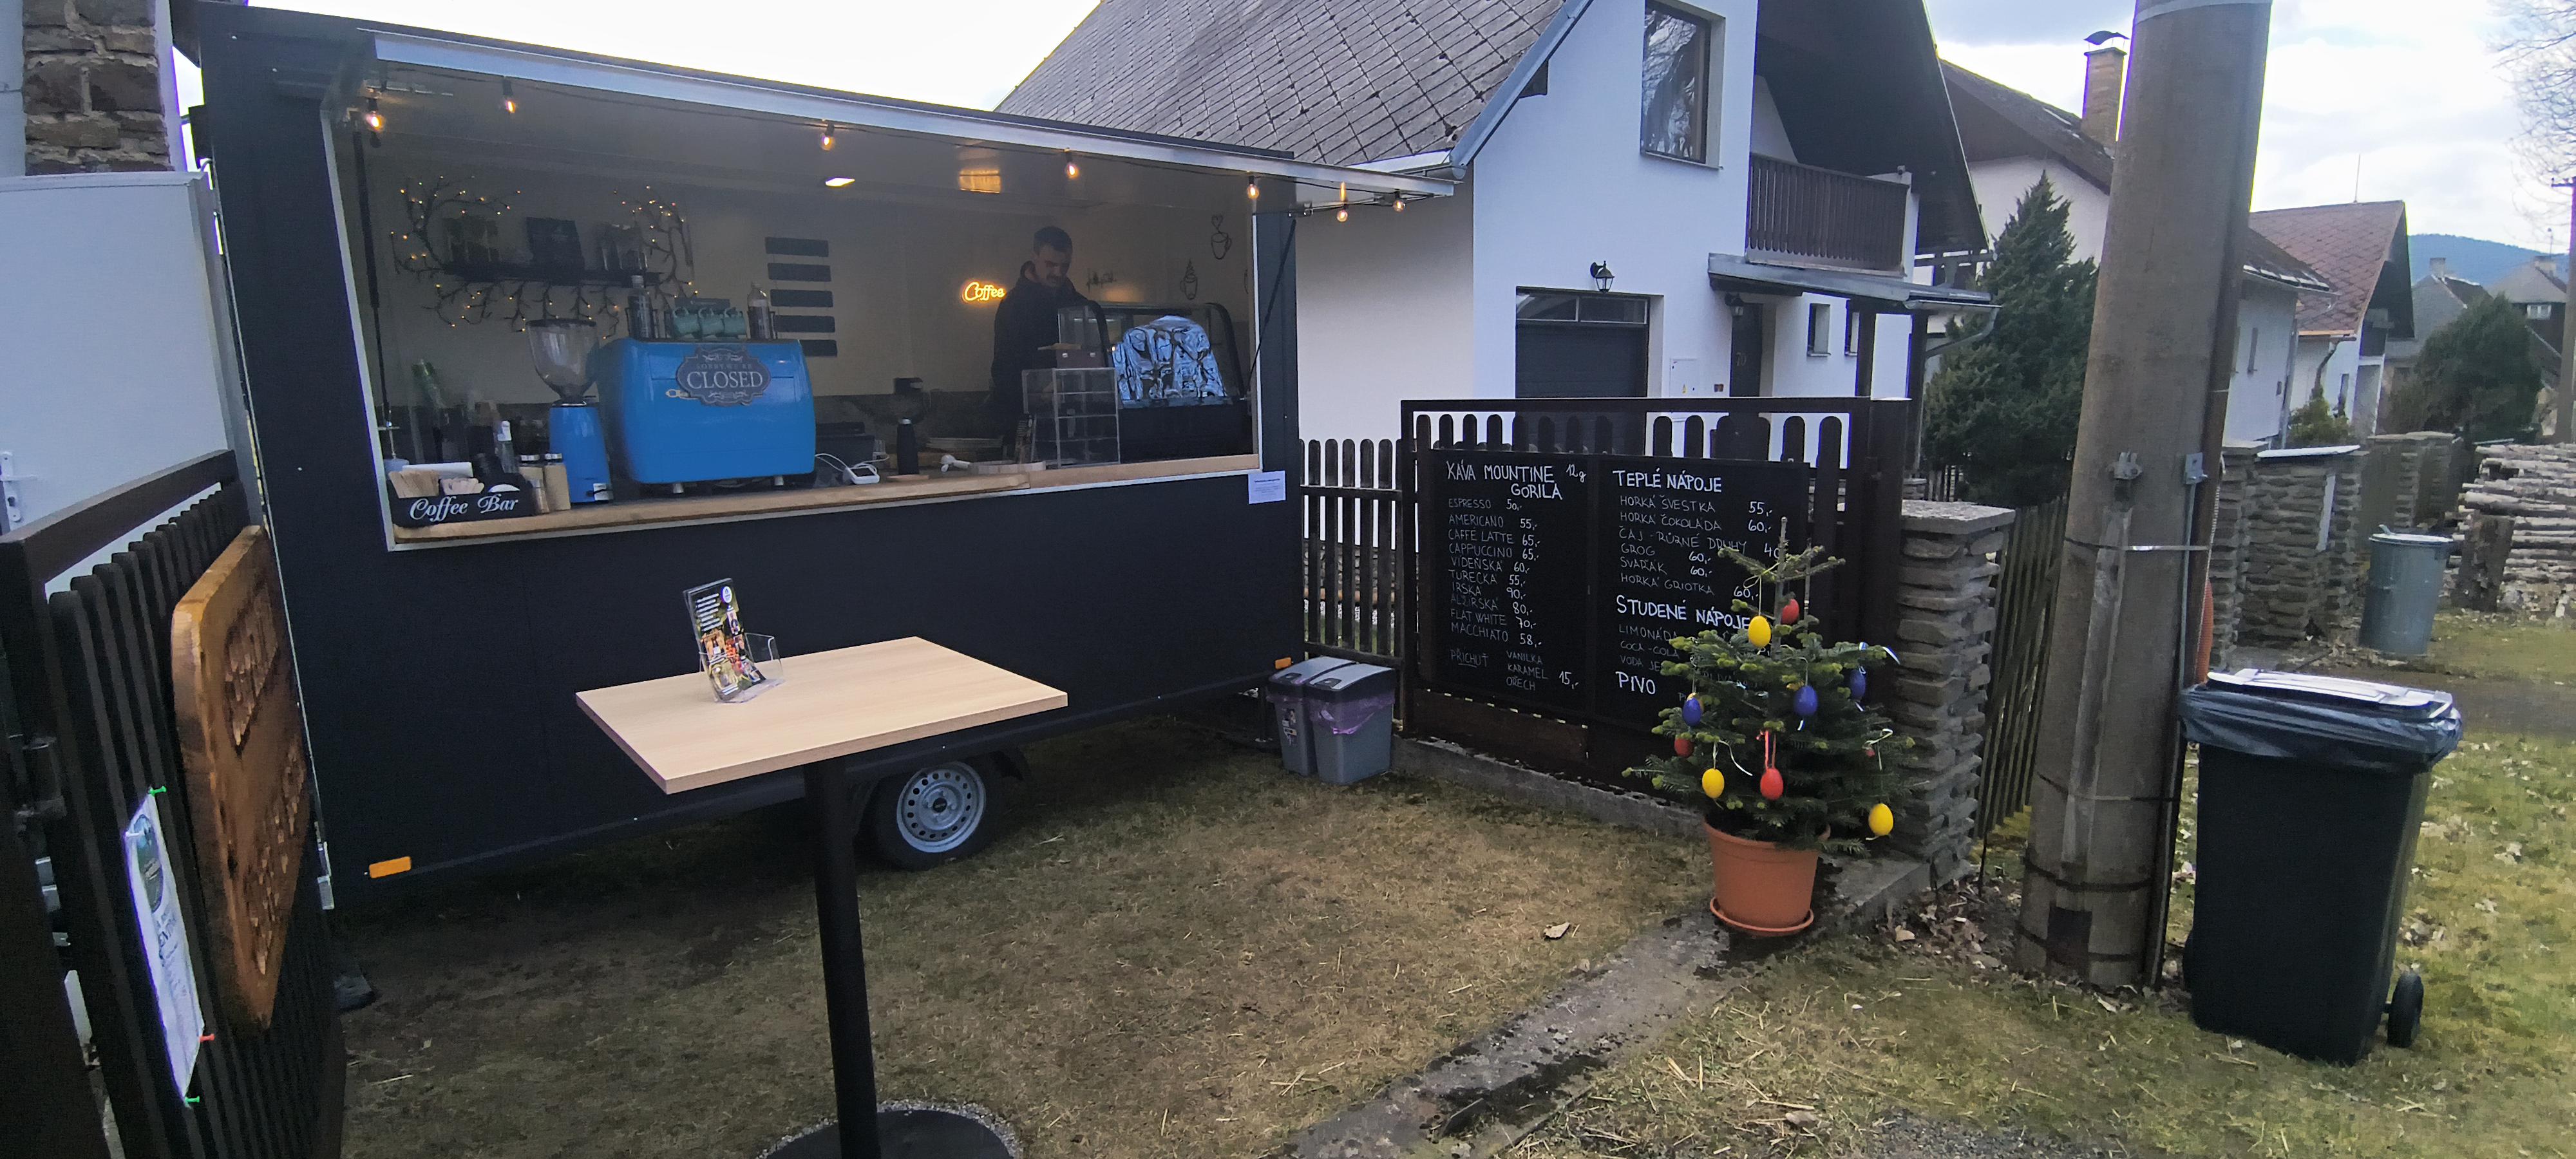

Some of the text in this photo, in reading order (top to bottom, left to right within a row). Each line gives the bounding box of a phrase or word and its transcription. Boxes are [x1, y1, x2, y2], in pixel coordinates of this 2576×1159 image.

[963, 281, 1005, 301] Coffee
[687, 371, 763, 389] CLOSED
[1446, 459, 1476, 481] KÁVA
[1484, 465, 1555, 483] MOUNTINE
[1612, 467, 1722, 493] TEPLÉ NÁPOJE
[1511, 484, 1563, 500] GORILA
[410, 493, 518, 522] Coffee Bar
[1448, 498, 1492, 509] ESPRESSO
[1620, 495, 1656, 509] HORKÁ
[1660, 495, 1716, 513] ŠVESTKA
[1448, 514, 1504, 528] AMERICANO
[1620, 511, 1656, 525] HORKÁ
[1481, 531, 1514, 544] LATTE
[1619, 525, 1643, 541] ČAJ
[1449, 543, 1512, 558] CAPPUCCINO
[1621, 543, 1655, 556] GROG
[1620, 573, 1660, 587] HORKÁ
[1664, 580, 1715, 595] GRIOTKA
[1450, 608, 1472, 621] FLAT
[1475, 612, 1507, 626] WHITE
[1616, 594, 1750, 629] STUDENÉ NÁPOJE
[1451, 622, 1508, 642] MACCHIATO
[1506, 650, 1543, 664] VANILKA
[1620, 655, 1643, 666] VODA
[1508, 664, 1549, 679] KARAMEL
[1616, 672, 1656, 695] PIVO
